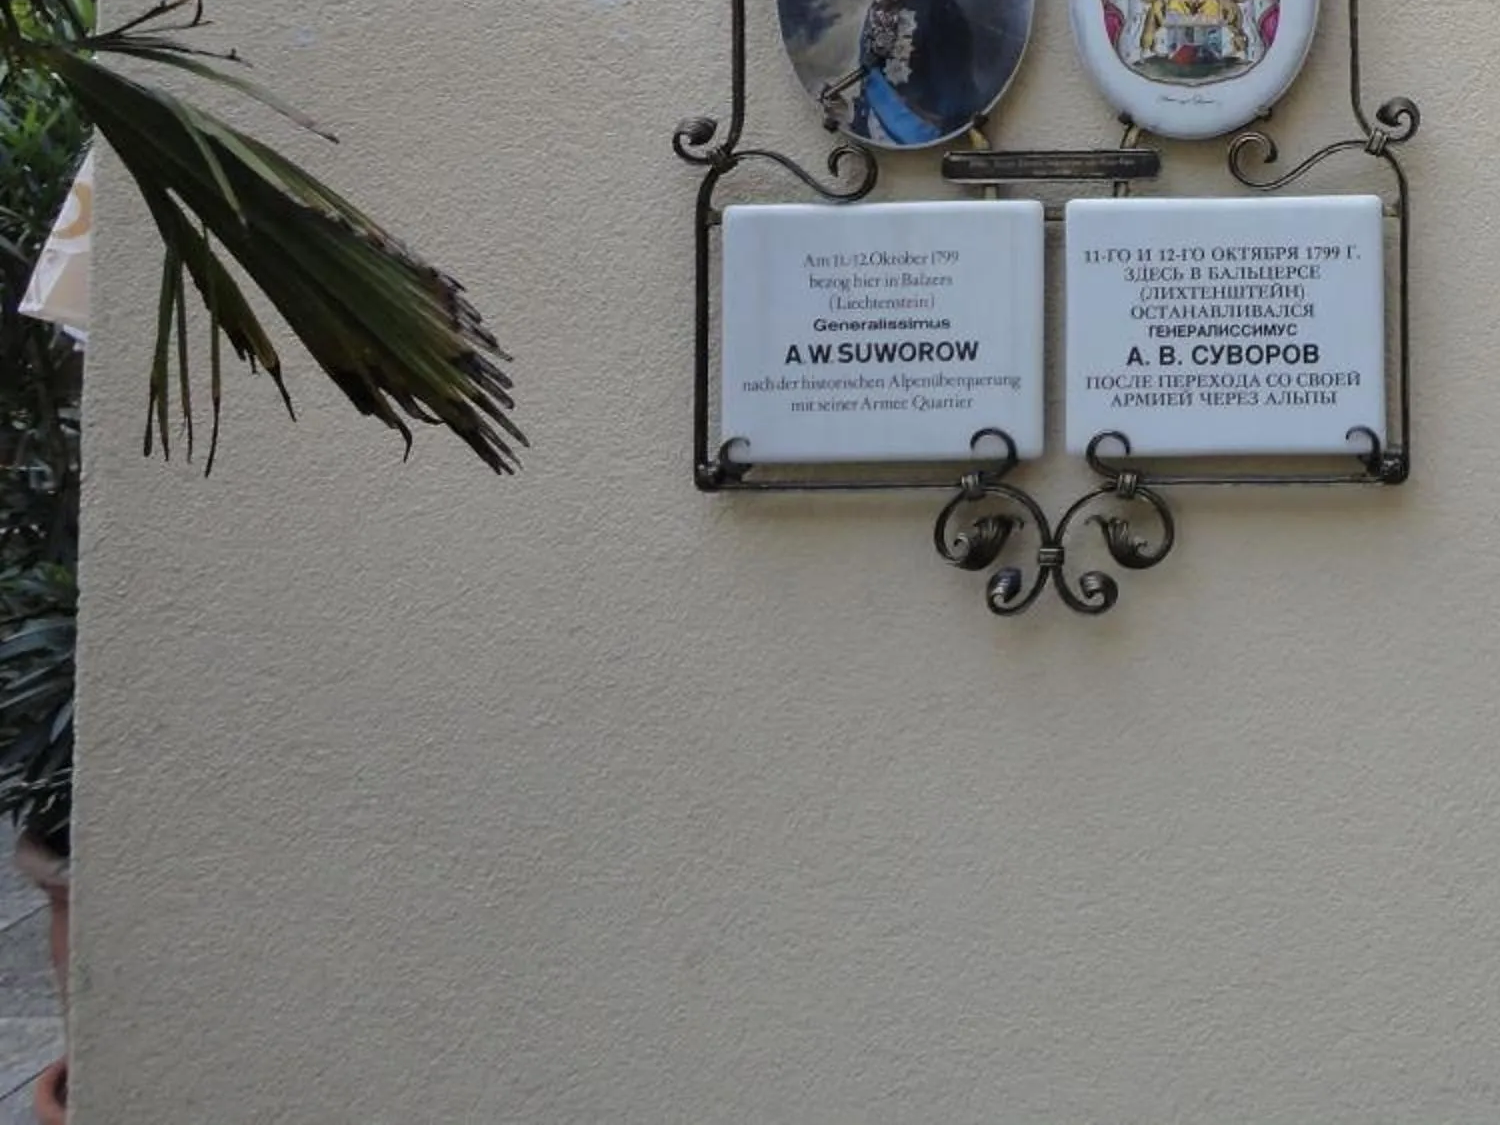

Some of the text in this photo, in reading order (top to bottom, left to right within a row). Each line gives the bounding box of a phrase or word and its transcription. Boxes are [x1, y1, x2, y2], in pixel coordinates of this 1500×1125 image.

[930, 250, 959, 266] 1799
[1085, 248, 1131, 263] 11-ГО
[1137, 248, 1152, 262] И
[1160, 246, 1205, 262] 12-ГО
[1211, 246, 1299, 262] ОКТЯБРЯ
[1307, 246, 1339, 260] 1799
[809, 272, 953, 292] bezog hier in Balzers
[1123, 265, 1321, 283] ЗДЕСЬ В БАЛЬЦЕРСЕ
[1140, 283, 1305, 302] (ЛИХТЕНШТЕЙН)
[1131, 304, 1314, 319] ОСТАНАВЛИВАЛСЯ
[813, 317, 951, 332] Generalissimus
[1148, 323, 1298, 338] ГЕНЕРАЛИССИМУС
[1191, 343, 1320, 366] СУВОРОВ
[743, 376, 775, 392] nach
[802, 373, 885, 389] historischen
[1086, 371, 1360, 390] ПОСЛЕ ПЕРЕХОДА СО СВОЕЙ
[818, 397, 858, 412] seiner
[861, 396, 908, 411] Armee
[911, 394, 975, 412] Quartier
[1111, 390, 1337, 407] АРМИЕЙ ЧЕРЕЗ АЛЬПЫ
